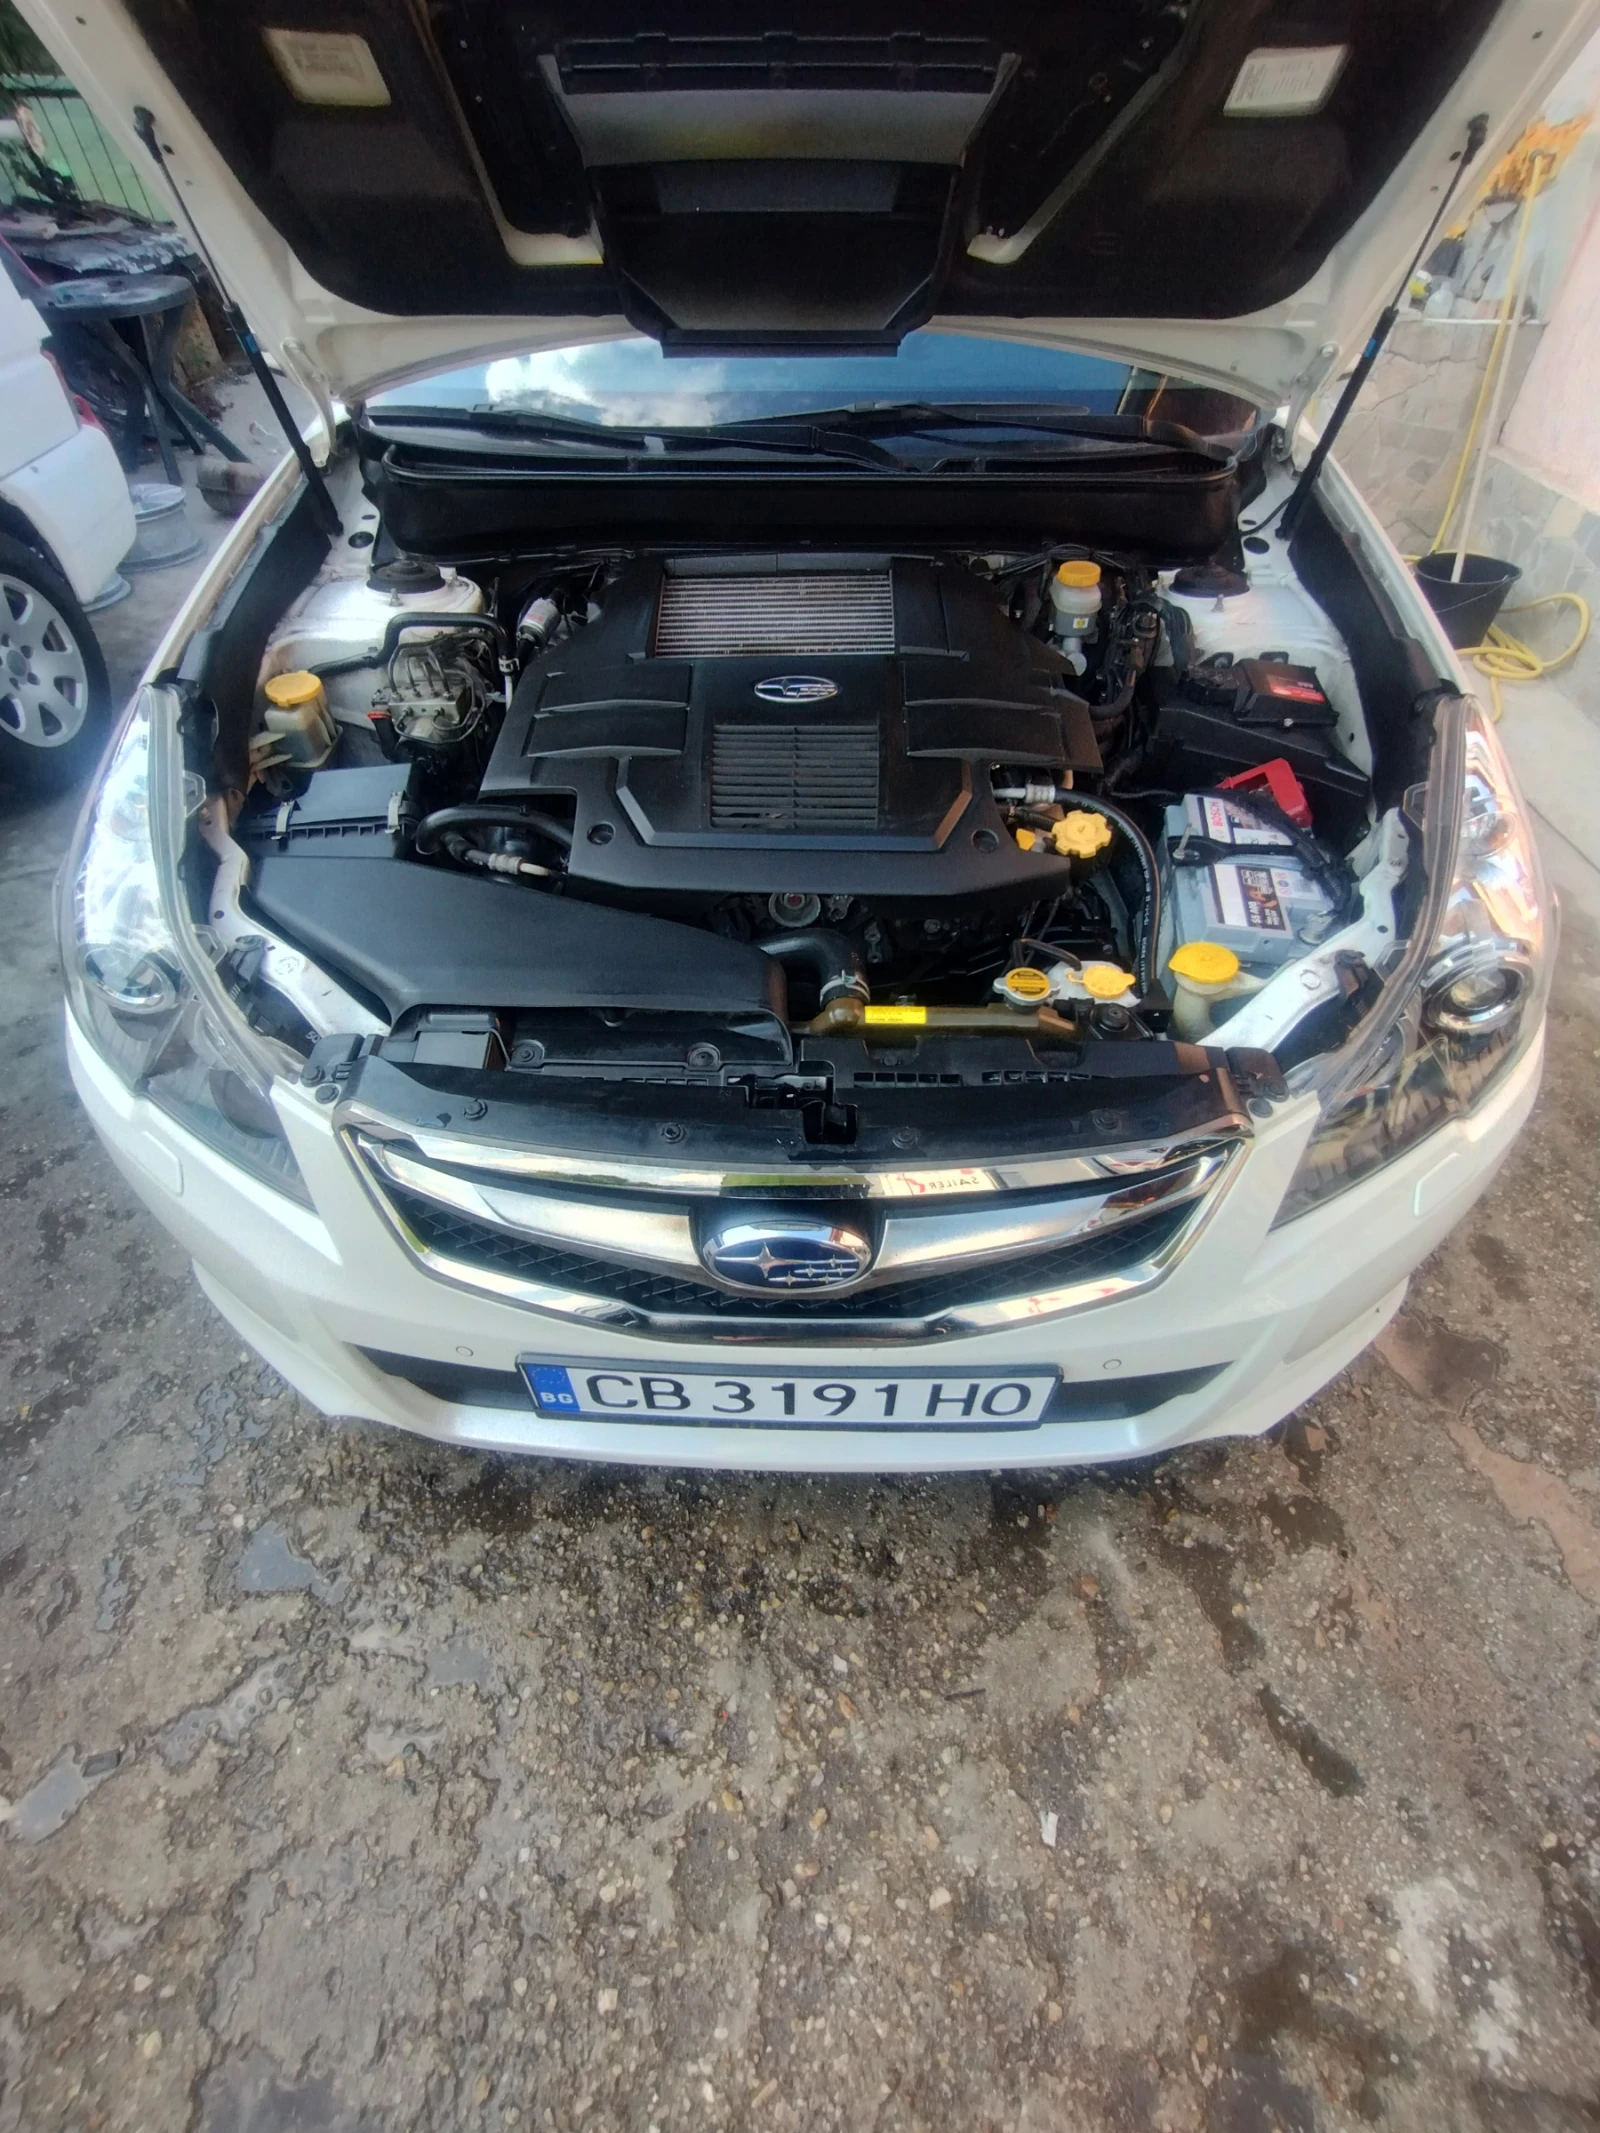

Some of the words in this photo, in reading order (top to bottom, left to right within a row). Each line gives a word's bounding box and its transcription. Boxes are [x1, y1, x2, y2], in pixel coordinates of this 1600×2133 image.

[1210, 801, 1224, 828] BOSCH
[541, 1391, 574, 1405] BG
[586, 1374, 691, 1411] CB
[712, 1380, 899, 1417] 3191
[925, 1382, 1031, 1417] HO
